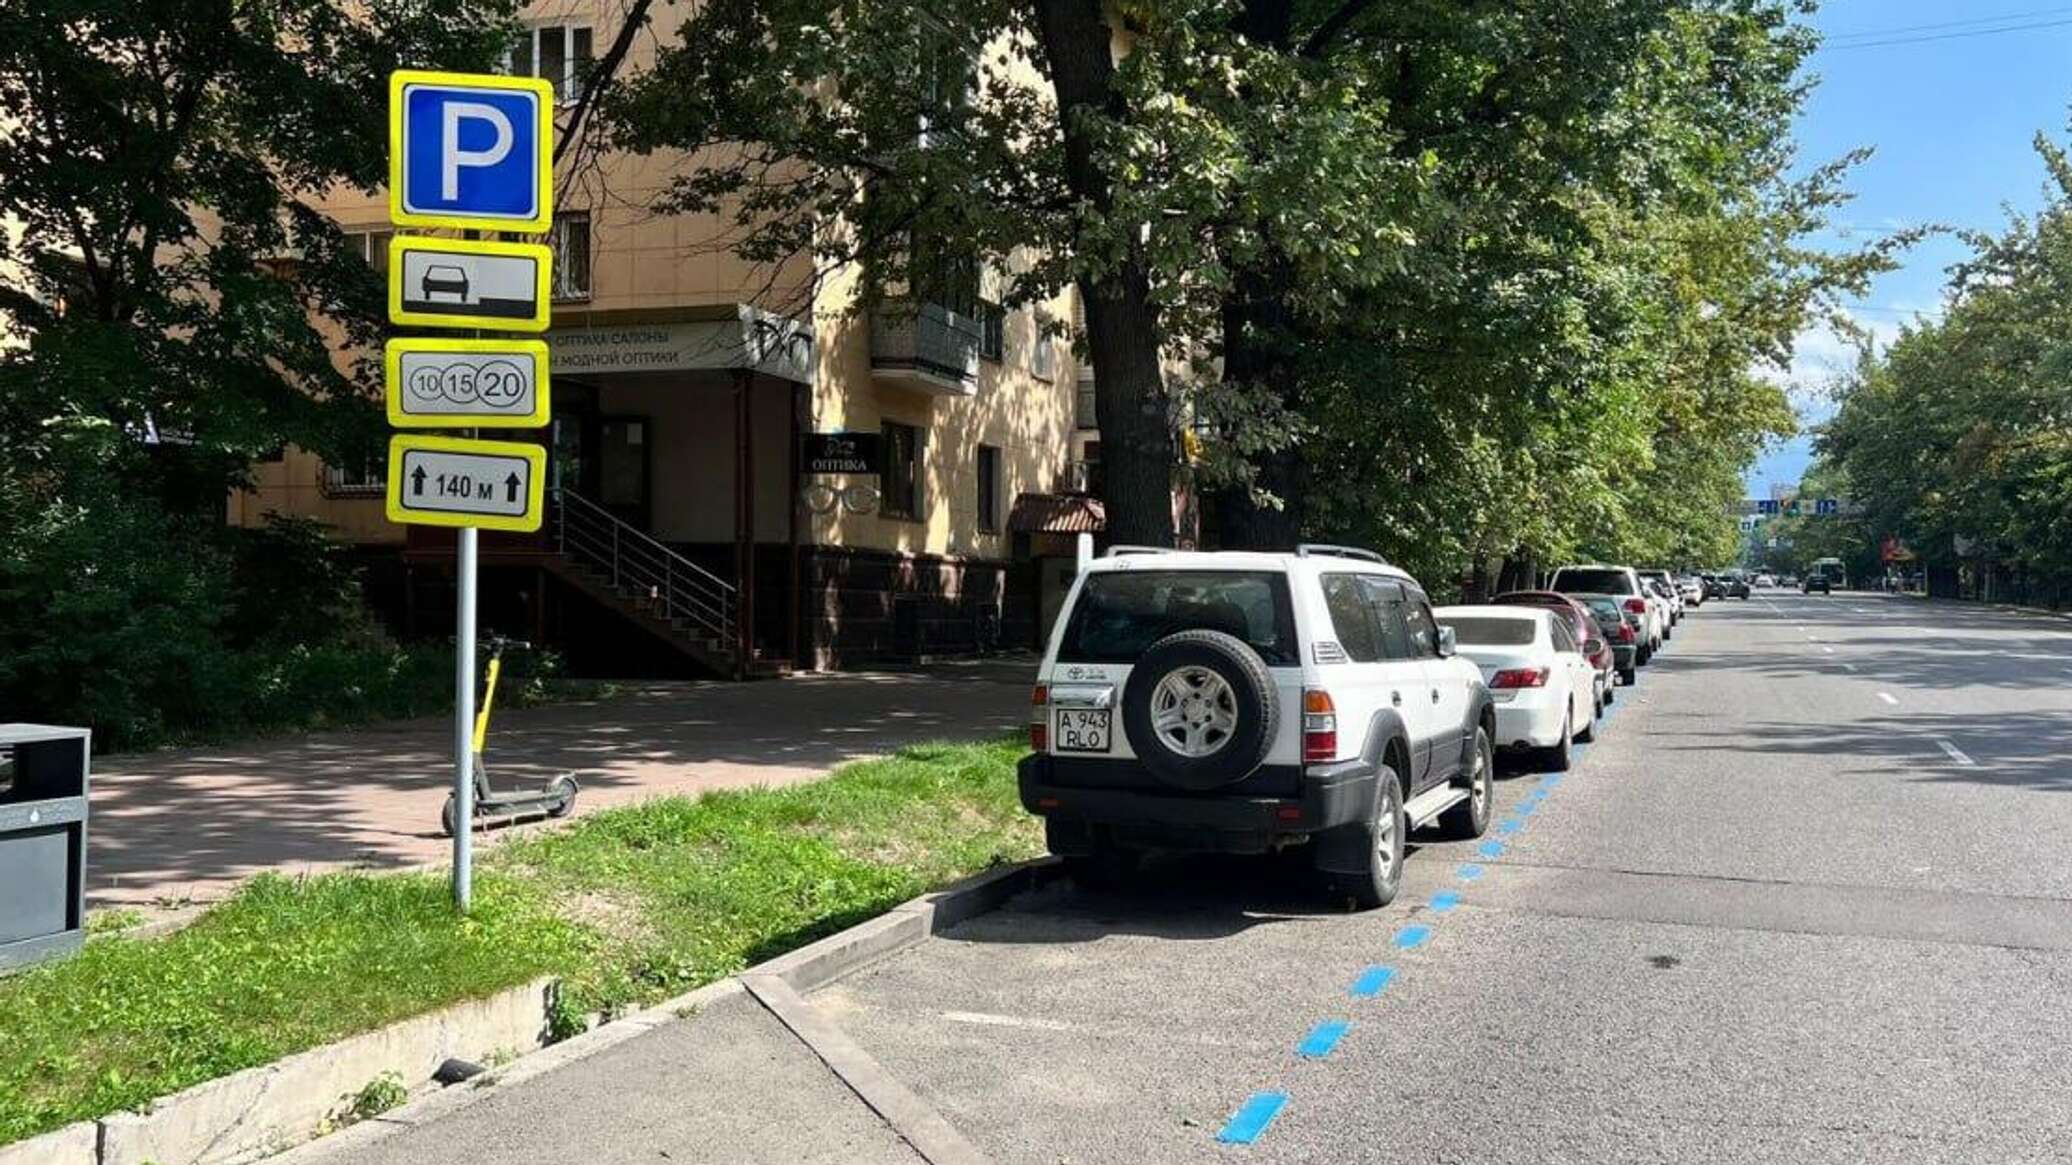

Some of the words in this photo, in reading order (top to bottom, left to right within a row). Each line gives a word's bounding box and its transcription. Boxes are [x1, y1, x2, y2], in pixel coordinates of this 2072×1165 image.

[442, 101, 514, 201] P
[611, 332, 669, 345] САЛОНЫ
[560, 351, 620, 367] МОДНОЙ
[622, 351, 679, 365] ОПТИКИ
[418, 374, 439, 392] 10
[448, 374, 474, 394] 15
[484, 373, 520, 397] 20
[812, 458, 868, 472] ОПТИКА
[436, 474, 471, 498] 140
[1061, 713, 1072, 728] A
[1078, 712, 1107, 728] 943
[1067, 730, 1100, 748] RLO
